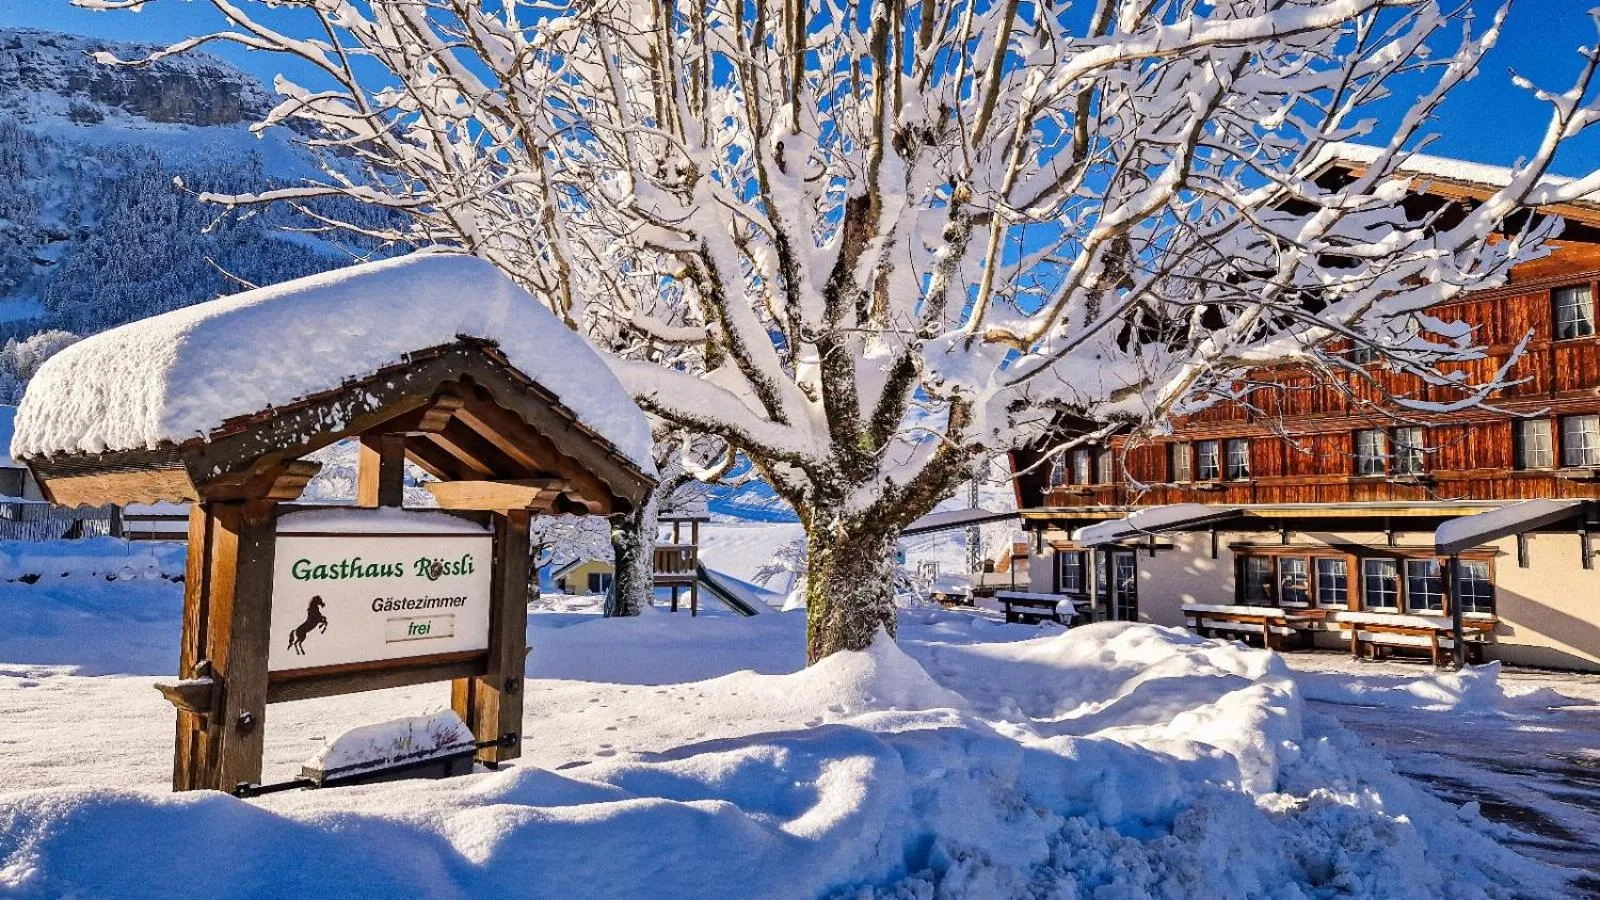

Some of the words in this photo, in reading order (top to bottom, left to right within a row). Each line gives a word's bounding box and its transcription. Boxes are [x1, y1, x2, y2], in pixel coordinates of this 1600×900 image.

[291, 556, 404, 582] Gasthaus
[413, 553, 476, 582] Rössli
[371, 595, 467, 612] Gästezimmer
[407, 620, 432, 636] frei
